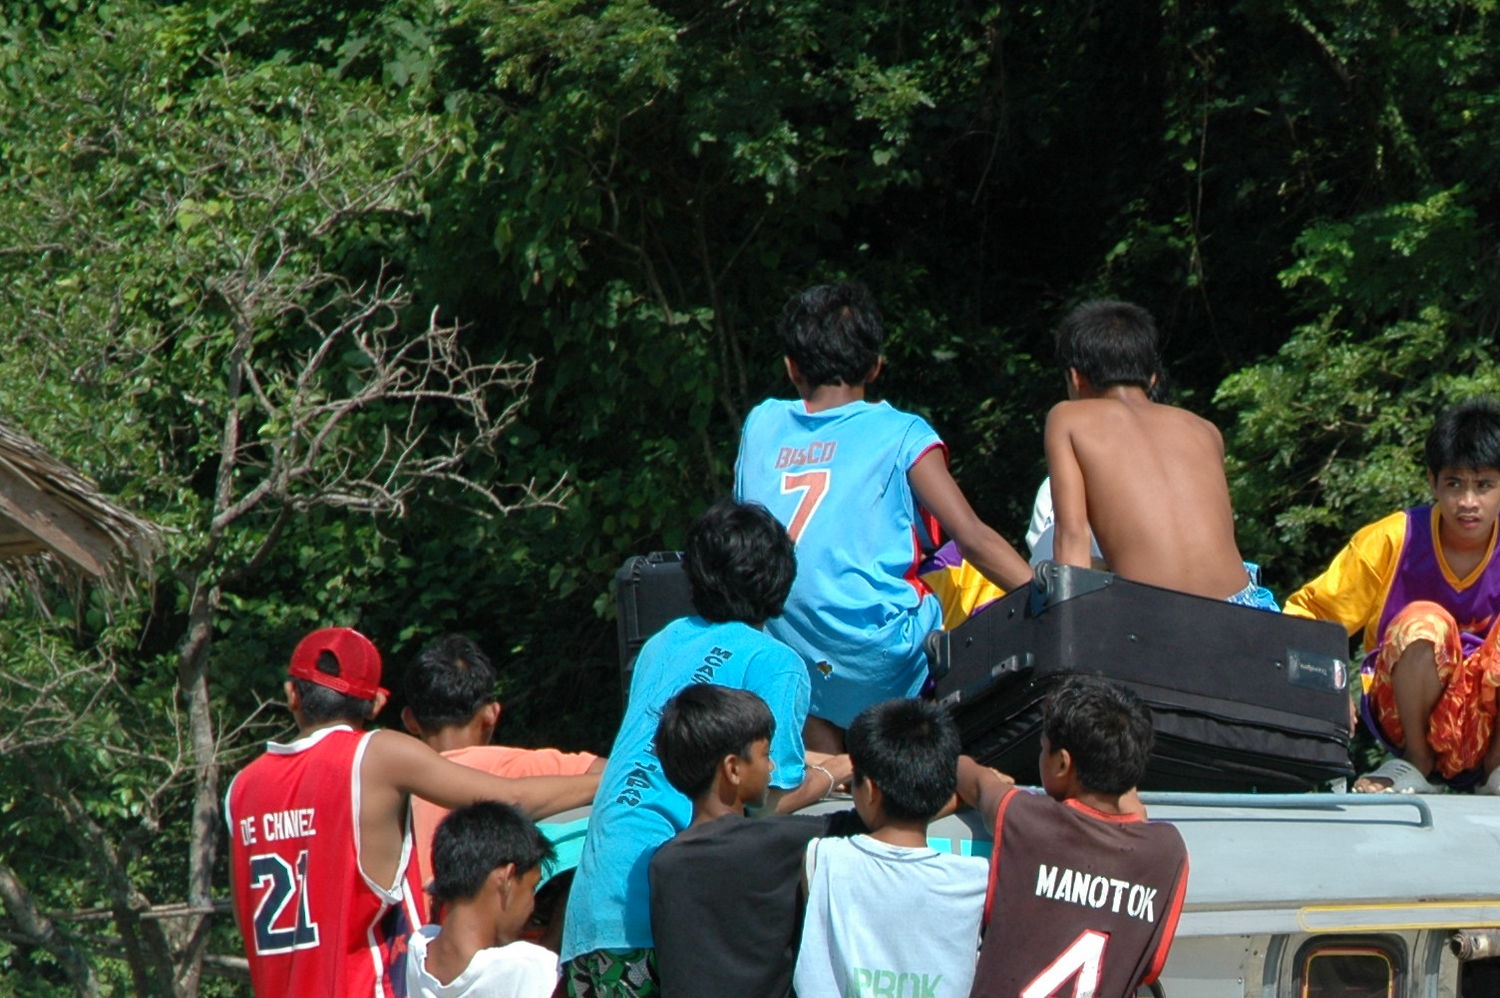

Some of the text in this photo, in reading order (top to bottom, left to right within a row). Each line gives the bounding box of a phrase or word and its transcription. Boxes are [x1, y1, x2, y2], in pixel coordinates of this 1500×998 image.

[780, 469, 830, 550] 7
[240, 808, 317, 846] DE CHAVEZ
[249, 850, 320, 956] 21
[1035, 864, 1157, 922] MANOTOK
